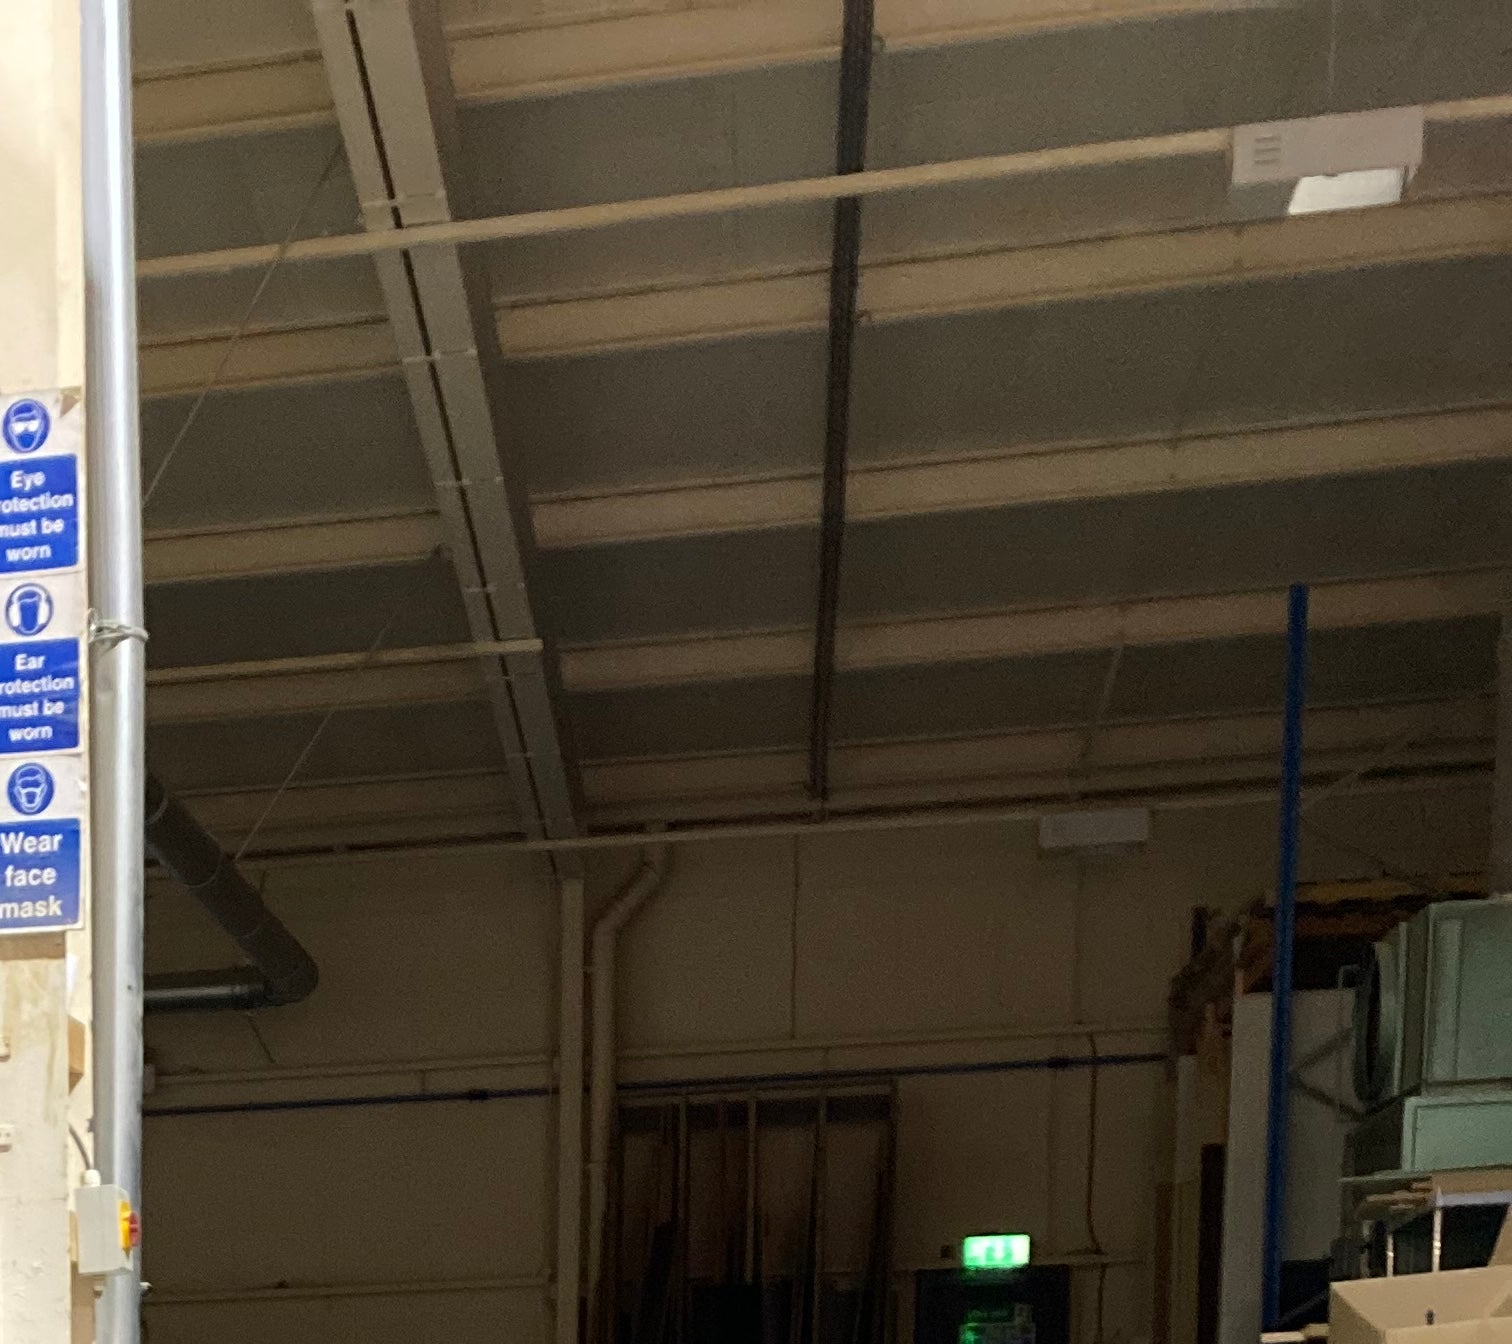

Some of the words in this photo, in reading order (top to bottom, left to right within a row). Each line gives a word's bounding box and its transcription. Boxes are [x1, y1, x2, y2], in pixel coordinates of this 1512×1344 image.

[10, 470, 45, 491] Eye
[40, 517, 64, 535] be
[6, 545, 51, 562] worn
[14, 654, 45, 671] Ear
[42, 699, 65, 716] be
[8, 724, 53, 741] worn
[0, 832, 63, 854] Wear
[4, 864, 57, 887] face
